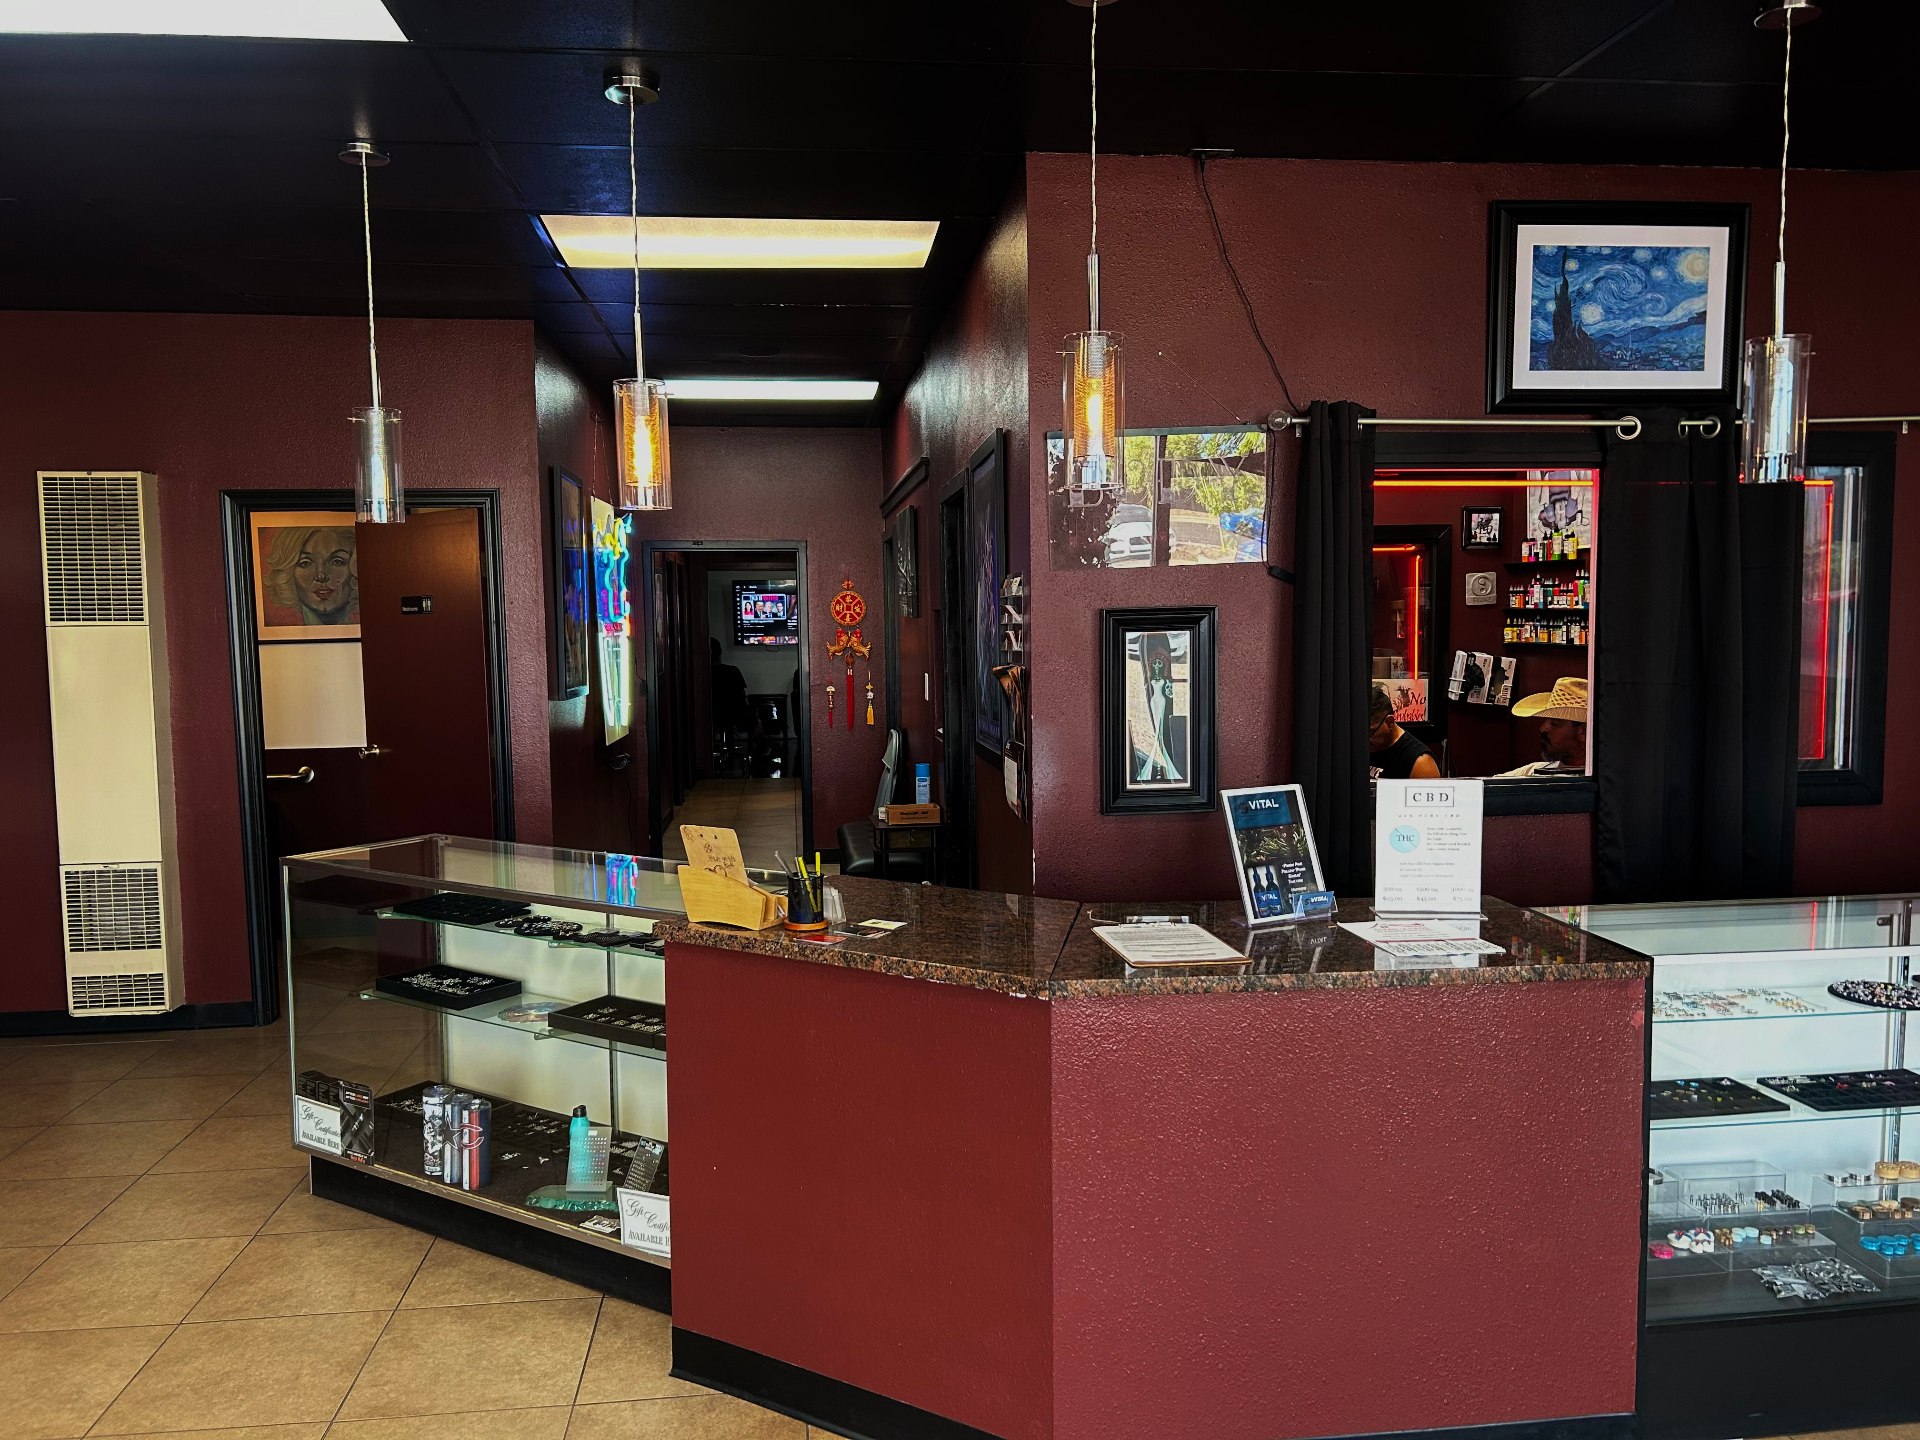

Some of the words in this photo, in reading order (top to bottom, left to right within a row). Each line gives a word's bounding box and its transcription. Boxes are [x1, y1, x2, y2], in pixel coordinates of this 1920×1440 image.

[1248, 798, 1279, 810] VITAL
[1396, 834, 1415, 842] THC
[302, 1130, 326, 1146] AVAILABLE
[327, 1140, 340, 1150] HERE
[626, 1198, 643, 1217] Gift
[628, 1229, 663, 1246] AVAILABLE
